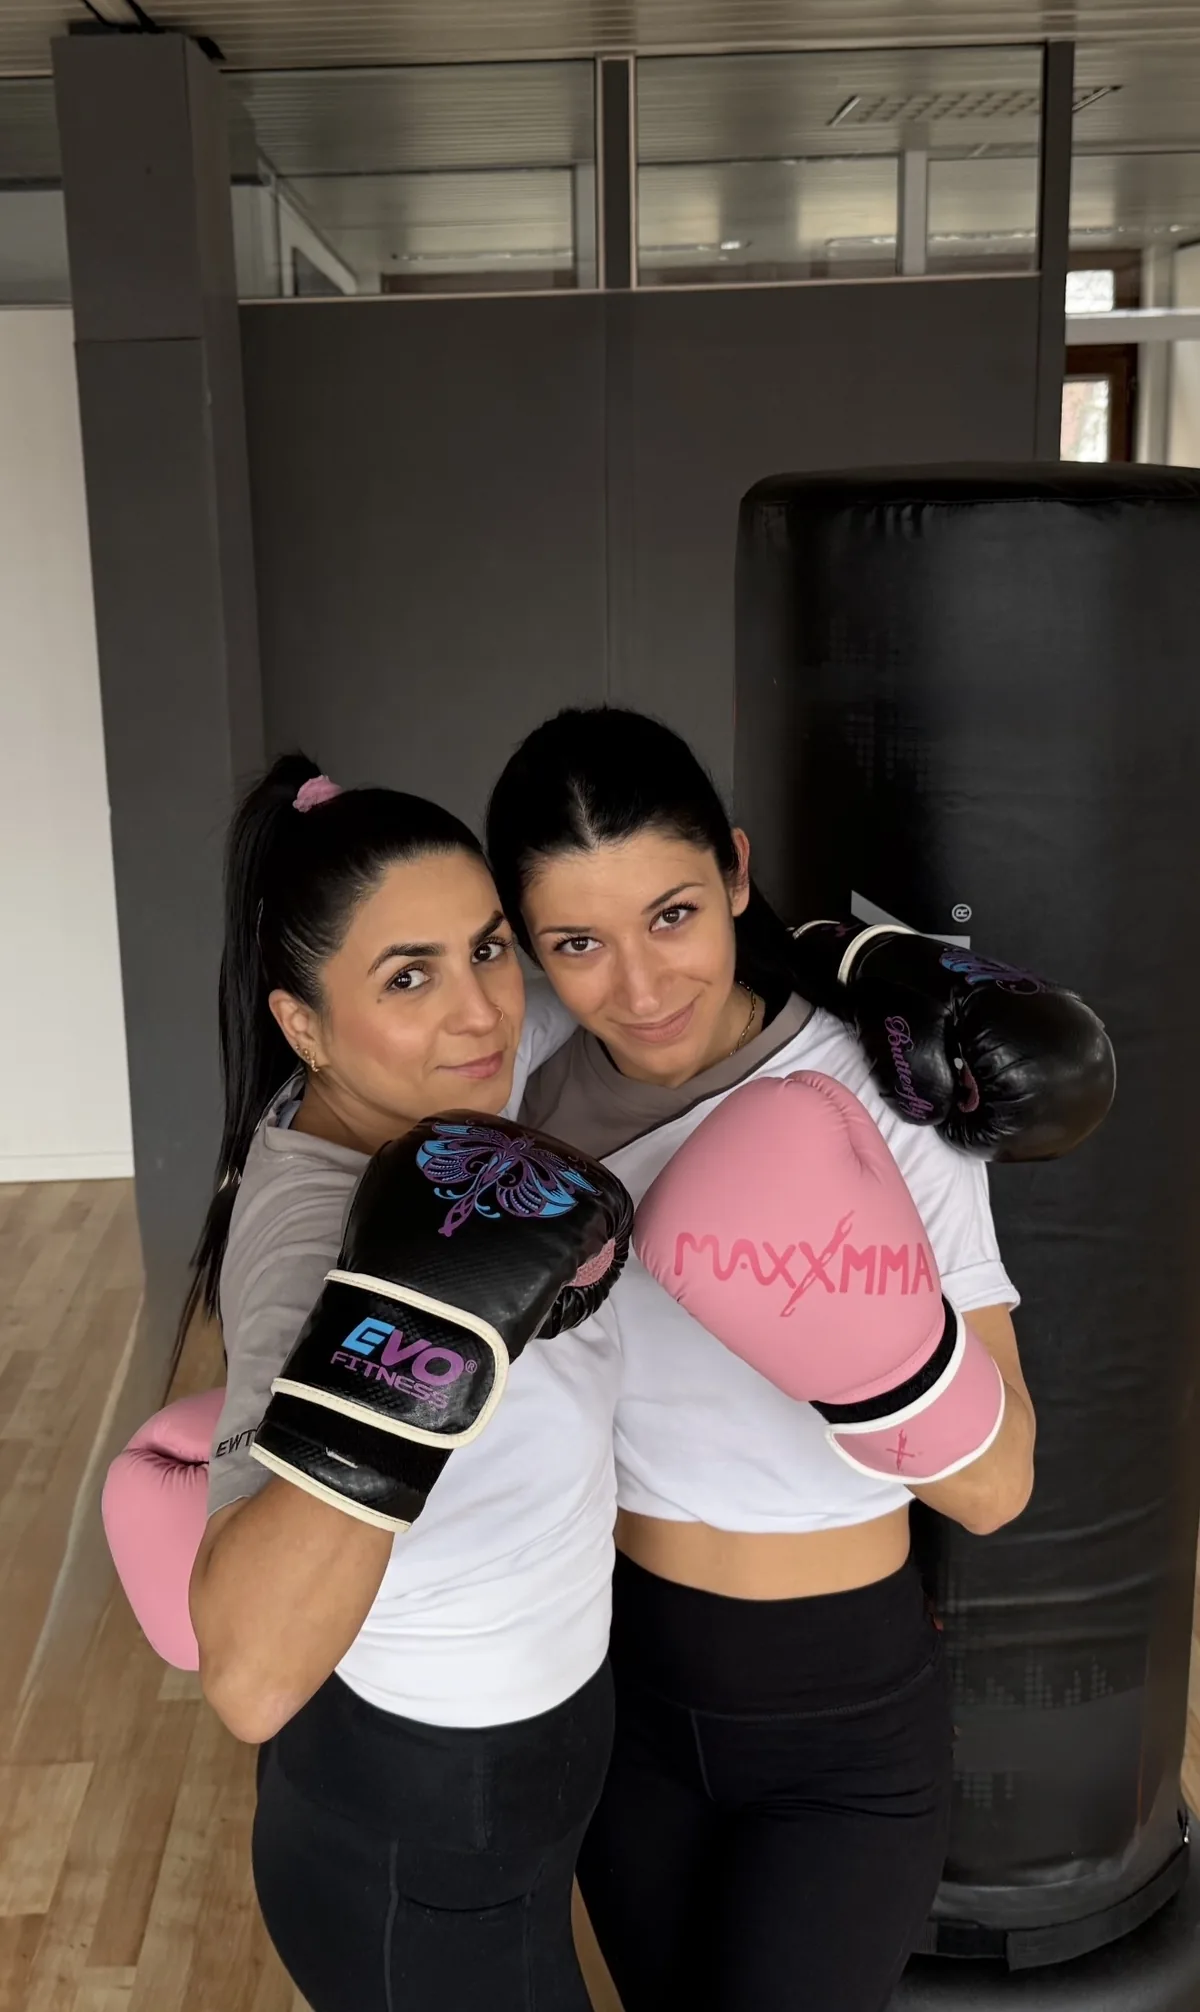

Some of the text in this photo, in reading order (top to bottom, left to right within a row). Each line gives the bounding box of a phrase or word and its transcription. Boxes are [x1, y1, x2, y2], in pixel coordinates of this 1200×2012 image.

[884, 1015, 934, 1120] Butterfly
[674, 1210, 934, 1317] MAXXMMA
[330, 1350, 448, 1409] FITNESS
